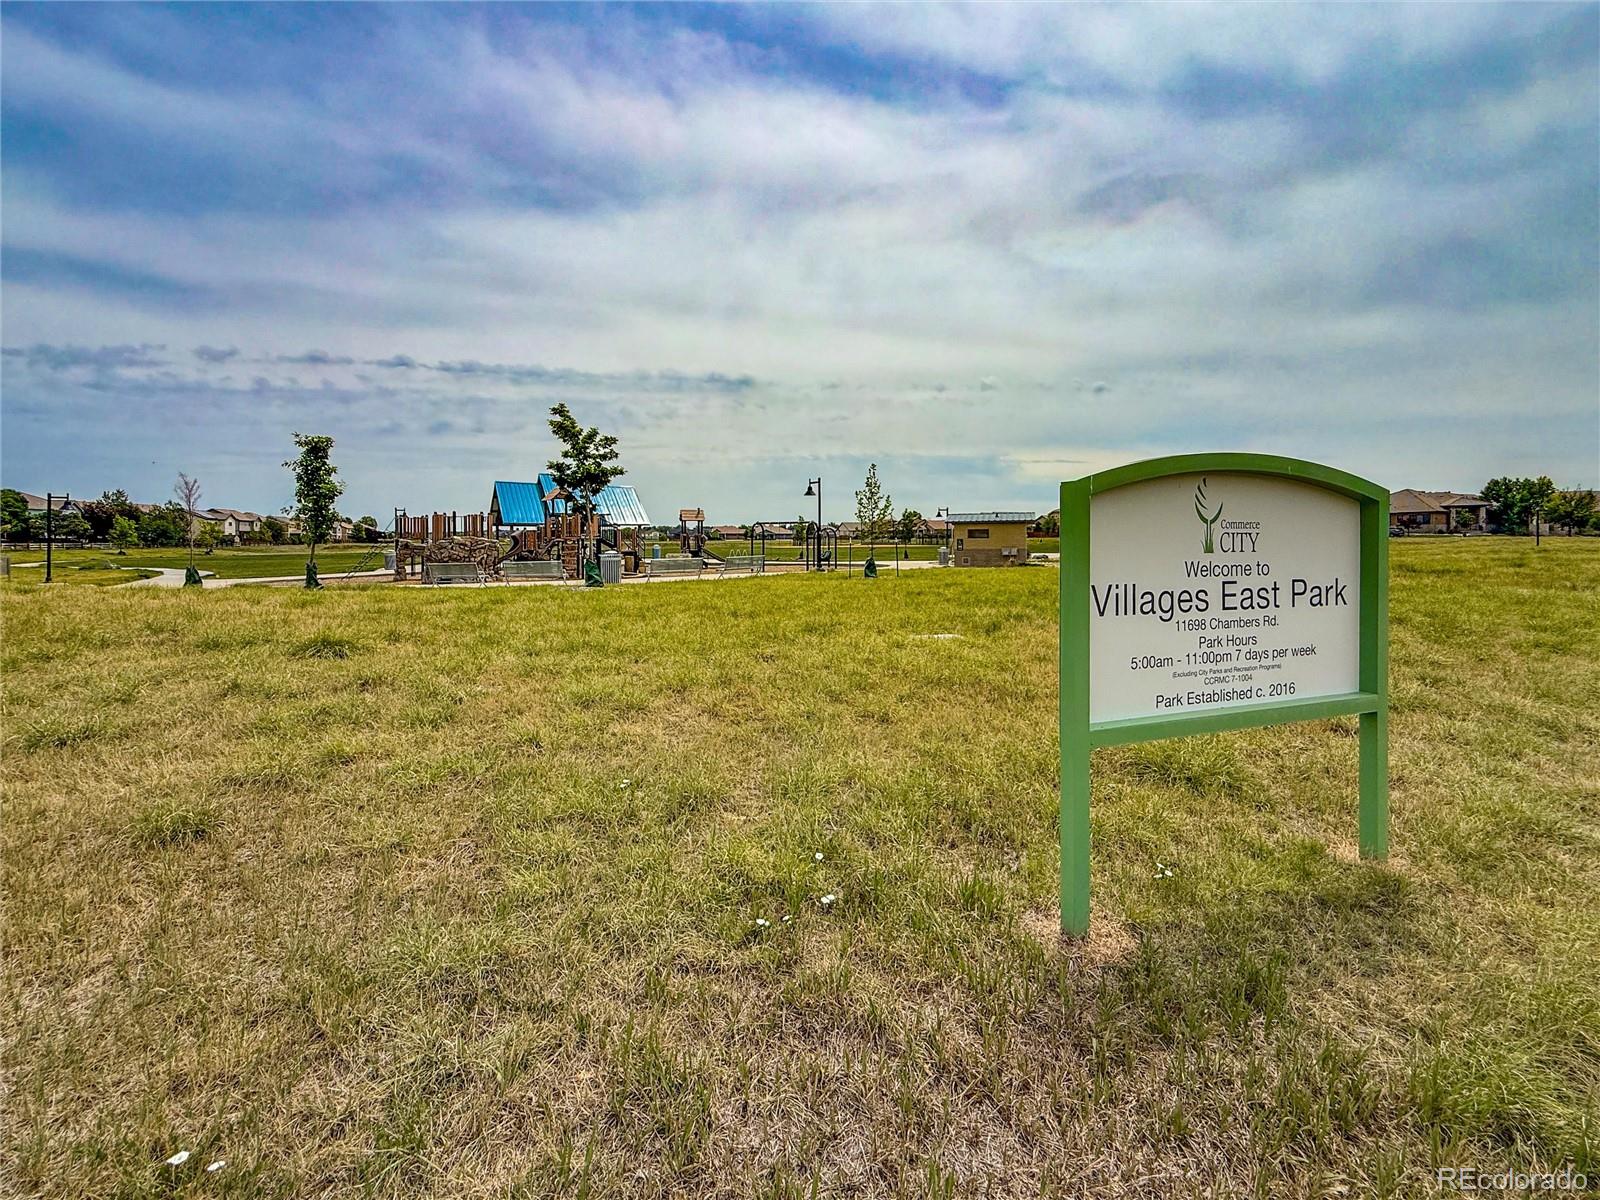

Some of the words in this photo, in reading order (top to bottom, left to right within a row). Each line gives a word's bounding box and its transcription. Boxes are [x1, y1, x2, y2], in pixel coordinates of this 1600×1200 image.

[1221, 520, 1260, 529] Commerce
[1220, 532, 1260, 553] CITY
[1185, 561, 1252, 578] Welcome
[1256, 561, 1270, 576] to
[1091, 584, 1209, 622] Villages
[1222, 581, 1280, 611] East
[1291, 578, 1348, 607] Park
[1175, 619, 1206, 631] 11698
[1210, 617, 1260, 630] Chambers
[1263, 616, 1279, 627] Rd.
[1199, 636, 1223, 649] Park
[1226, 635, 1257, 646] Hours
[1130, 655, 1174, 670] 5:00am
[1185, 651, 1232, 666] 11:00pm
[1235, 650, 1241, 662] 7
[1244, 648, 1269, 663] days
[1272, 648, 1288, 661] per
[1291, 645, 1317, 656] week
[1209, 667, 1223, 675] Parks
[1234, 665, 1258, 673] Recreation
[1204, 676, 1230, 685] CCRMC
[1231, 674, 1252, 683] 7-1004
[1156, 695, 1183, 708] Park
[1187, 688, 1252, 705] Established
[1256, 688, 1265, 698] c.
[1269, 682, 1295, 696] 2016
